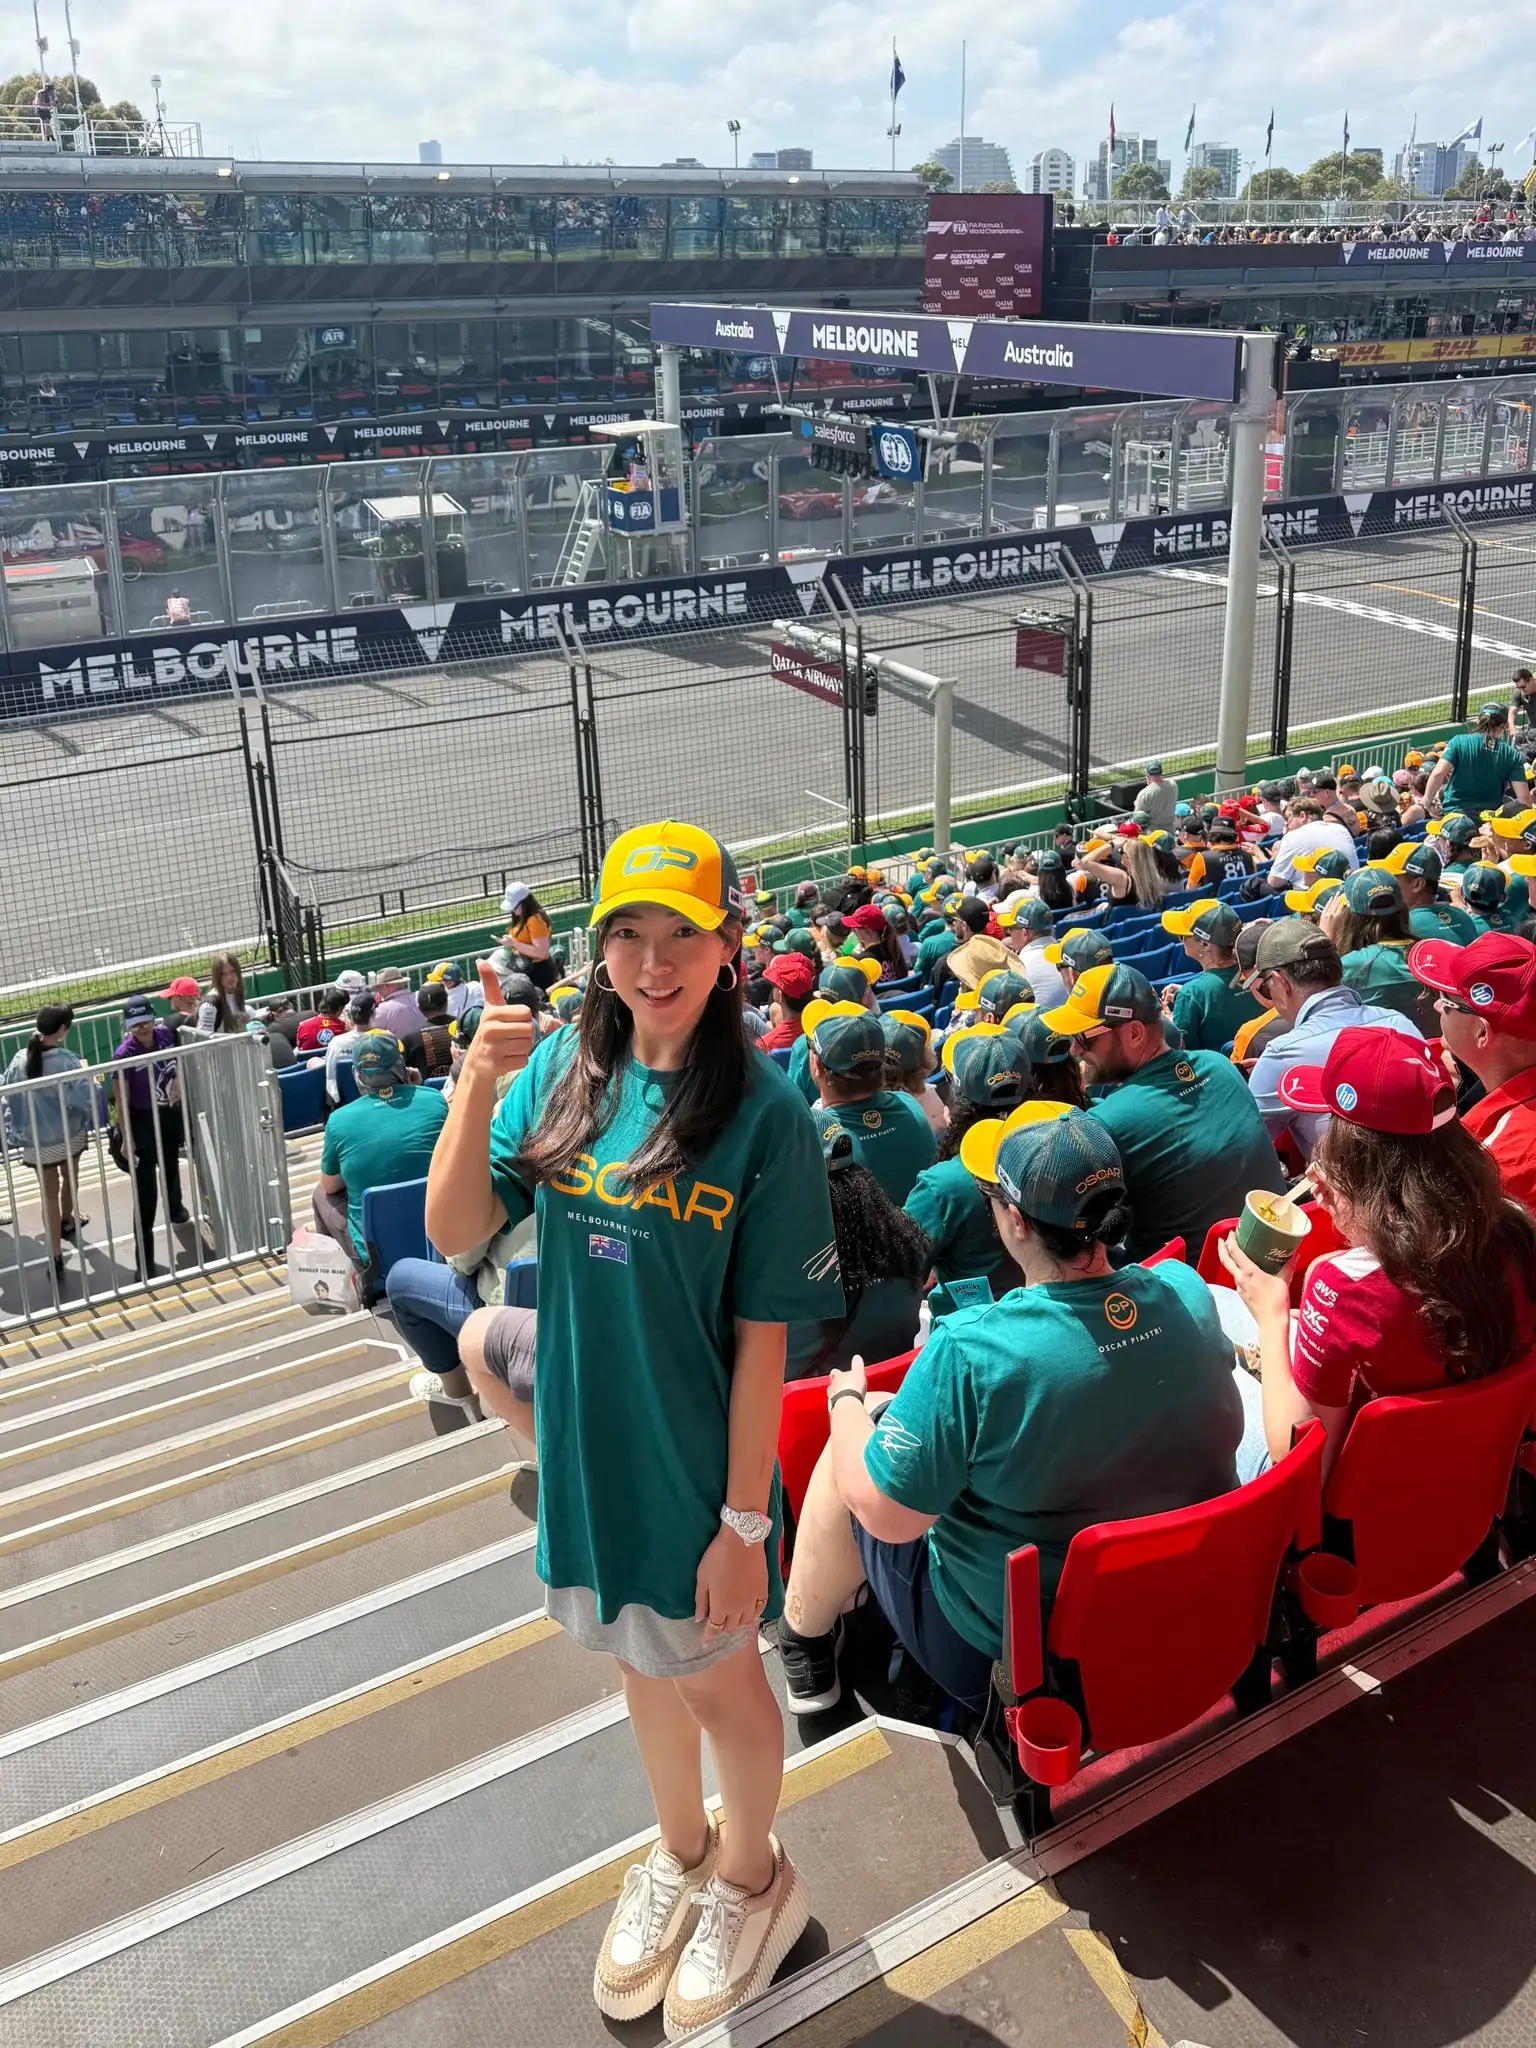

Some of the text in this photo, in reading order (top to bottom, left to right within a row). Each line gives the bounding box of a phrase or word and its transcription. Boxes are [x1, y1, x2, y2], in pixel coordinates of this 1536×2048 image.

[1368, 247, 1429, 260] MELBOURNE
[1467, 246, 1524, 258] MELBOURNE
[716, 320, 754, 339] Australia
[812, 324, 918, 358] MELBOURNE
[951, 337, 968, 349] MEL
[1431, 340, 1478, 357] DHL
[1004, 340, 1074, 368] Australia
[842, 397, 894, 409] MELBOURNE
[569, 412, 630, 426] MELBOURNE
[680, 408, 725, 418] LBOURNE
[354, 425, 423, 440] MELBOURNE
[465, 418, 530, 432] MELBOURNE
[235, 431, 309, 446] MELBOURNE
[814, 424, 856, 445] salesforce
[0, 448, 56, 460] BOURNE
[108, 439, 186, 455] MELBOURNE
[881, 435, 911, 471] FIA
[630, 503, 651, 518] FIA
[1394, 483, 1534, 522] MELBOURNE
[1154, 508, 1318, 556] MELBRNE
[863, 541, 1062, 596] MELBOURNE
[500, 582, 748, 643] MELBOURNE
[38, 626, 360, 699] MELBOURNE
[1224, 861, 1247, 879] 81
[1472, 984, 1493, 1004] hp
[319, 1030, 333, 1045] hp
[1338, 1085, 1355, 1108] hp
[866, 1112, 878, 1121] OP
[1075, 1167, 1122, 1194] OSCAR
[550, 1152, 734, 1231] SCAR
[567, 1211, 650, 1240] MELBOURNE VIC
[1314, 1279, 1338, 1302] aws
[1108, 1300, 1130, 1314] OP
[1098, 1326, 1163, 1354] OSCAR PIASTRI
